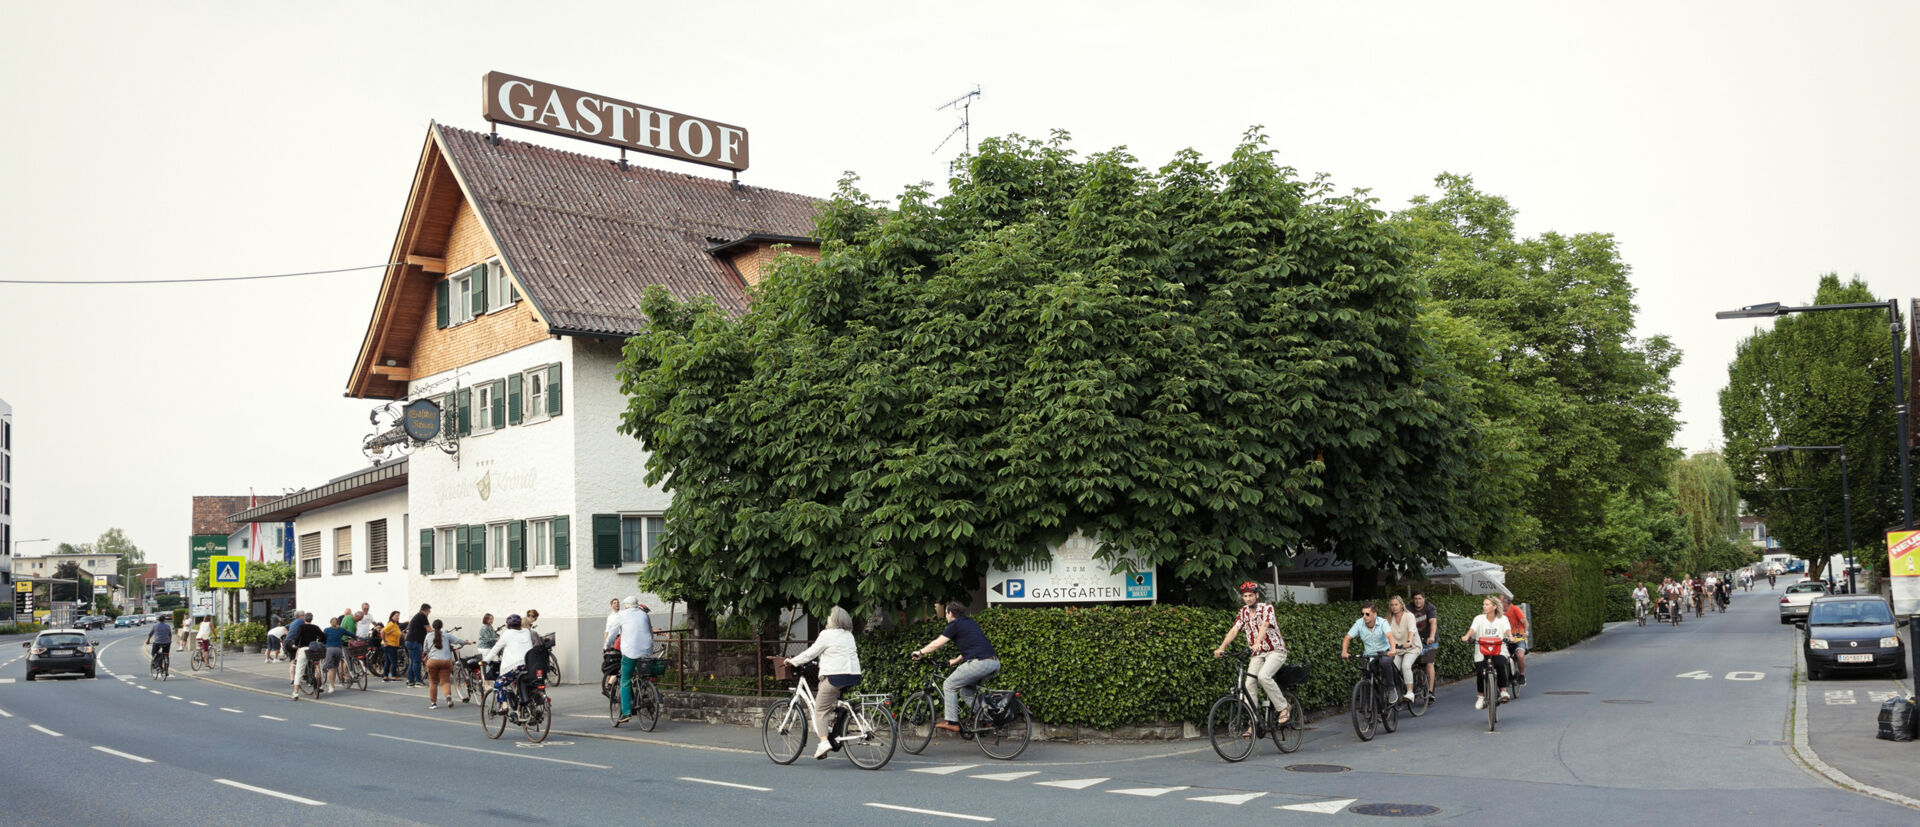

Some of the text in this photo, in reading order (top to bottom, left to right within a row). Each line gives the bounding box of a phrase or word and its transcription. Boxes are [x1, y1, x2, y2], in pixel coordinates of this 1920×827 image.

[498, 80, 744, 164] GASTHOF
[1009, 582, 1121, 599] P GASTGARTEN
[1675, 670, 1766, 681] 40
